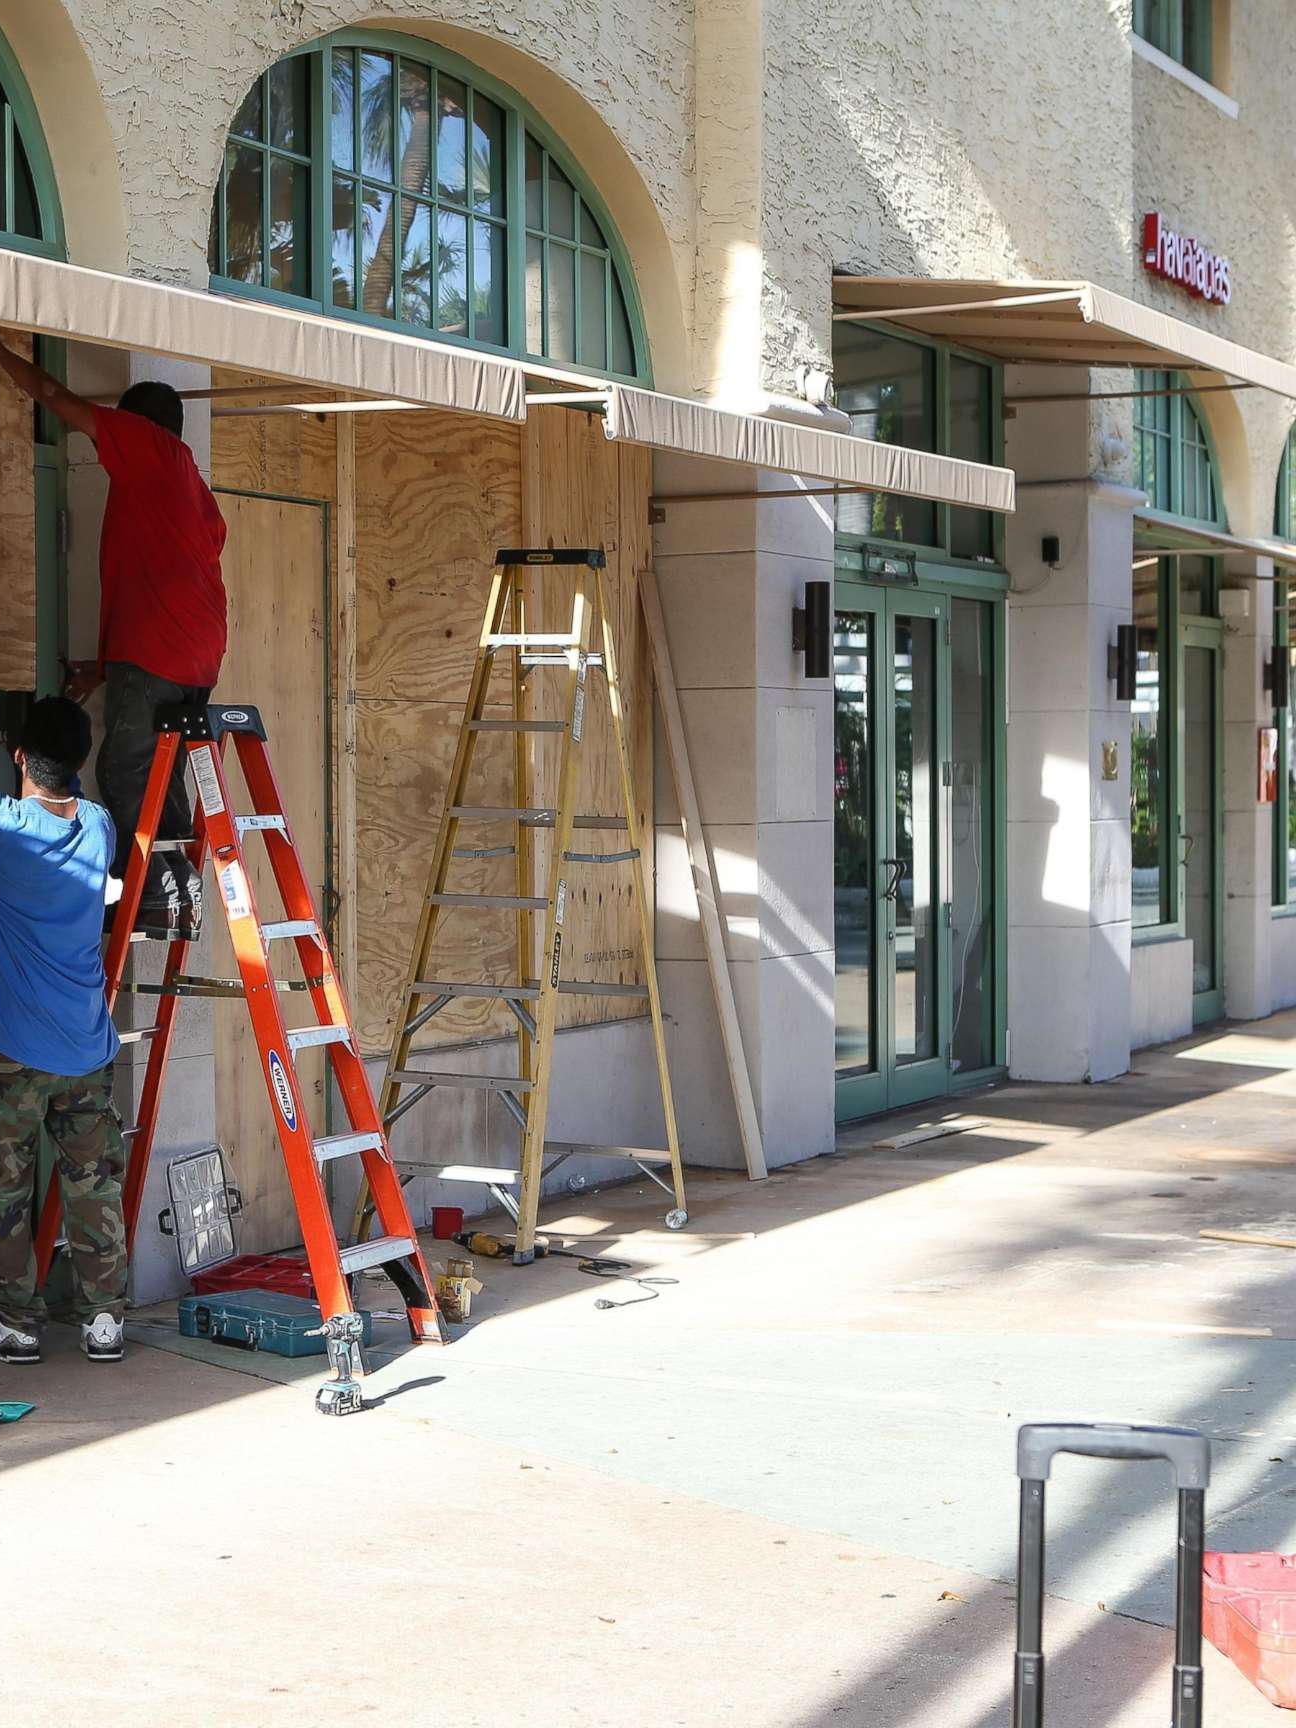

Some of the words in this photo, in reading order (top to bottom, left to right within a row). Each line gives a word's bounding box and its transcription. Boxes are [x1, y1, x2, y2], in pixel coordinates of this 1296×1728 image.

[1156, 212, 1233, 305] havaianas
[551, 935, 561, 986] STANLEY
[274, 1067, 292, 1115] WERNER
